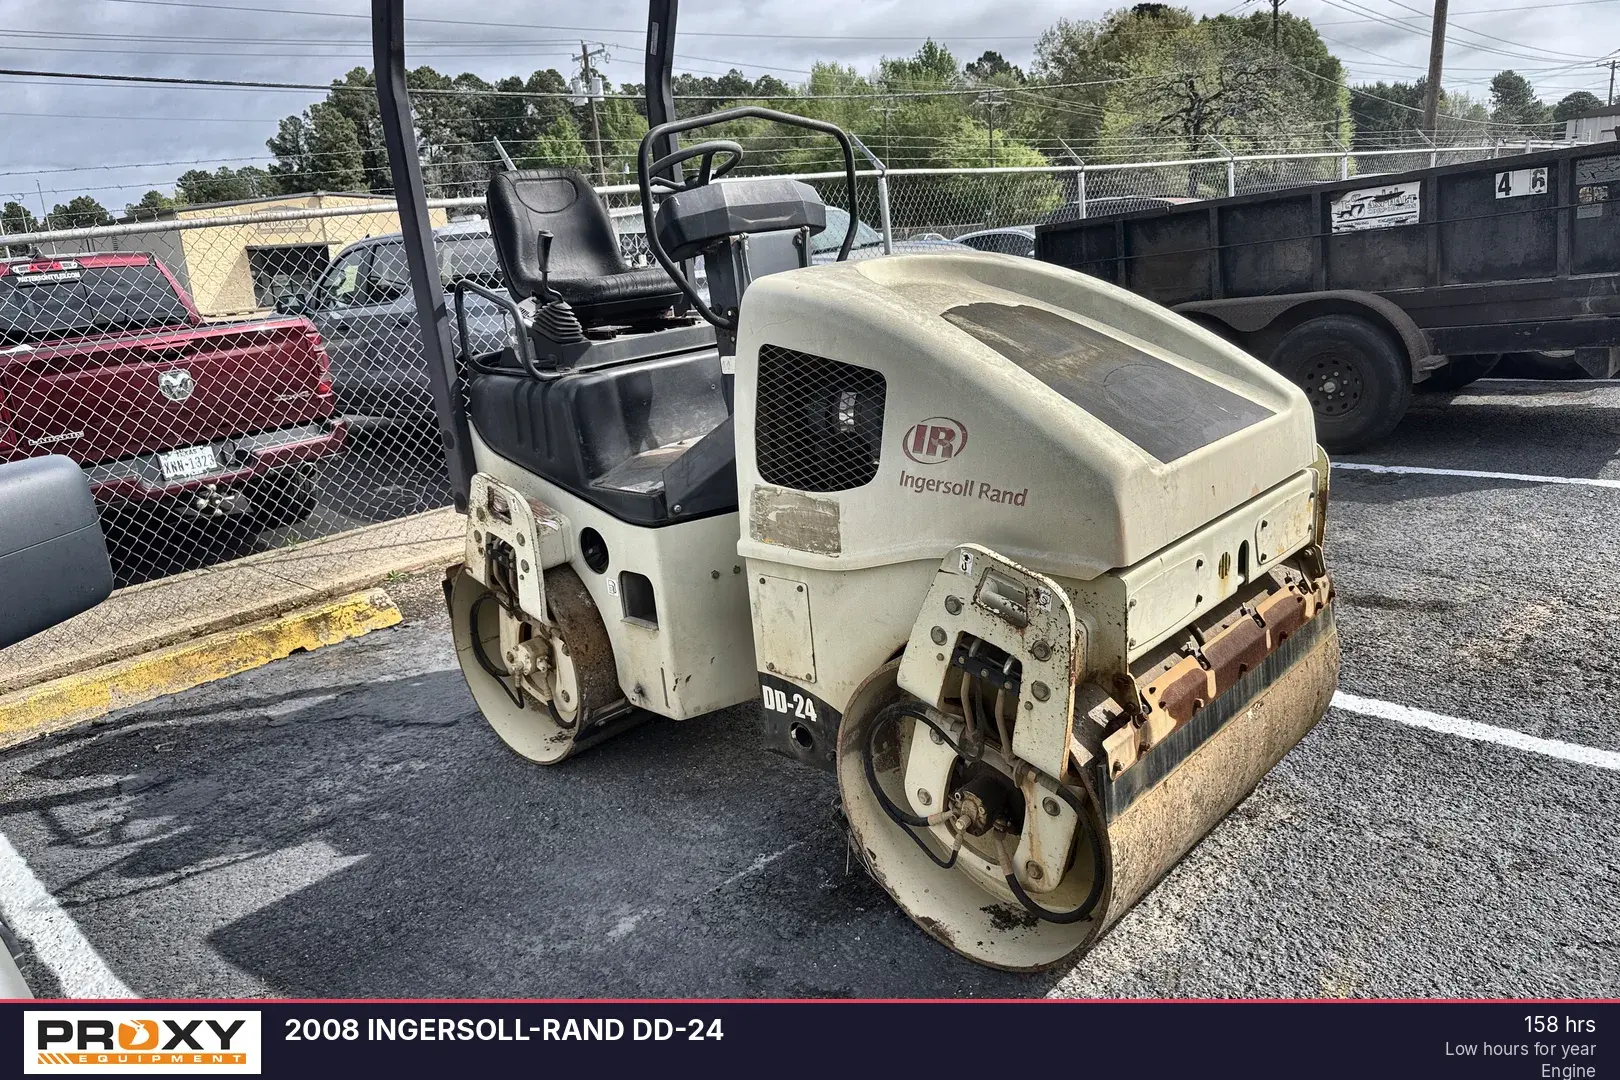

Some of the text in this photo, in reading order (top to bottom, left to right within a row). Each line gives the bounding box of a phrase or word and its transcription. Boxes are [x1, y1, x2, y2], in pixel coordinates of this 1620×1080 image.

[1498, 169, 1545, 196] 4 6
[912, 424, 956, 458] IR
[899, 470, 1029, 507] Ingersoll Rand
[762, 684, 818, 722] DD-24
